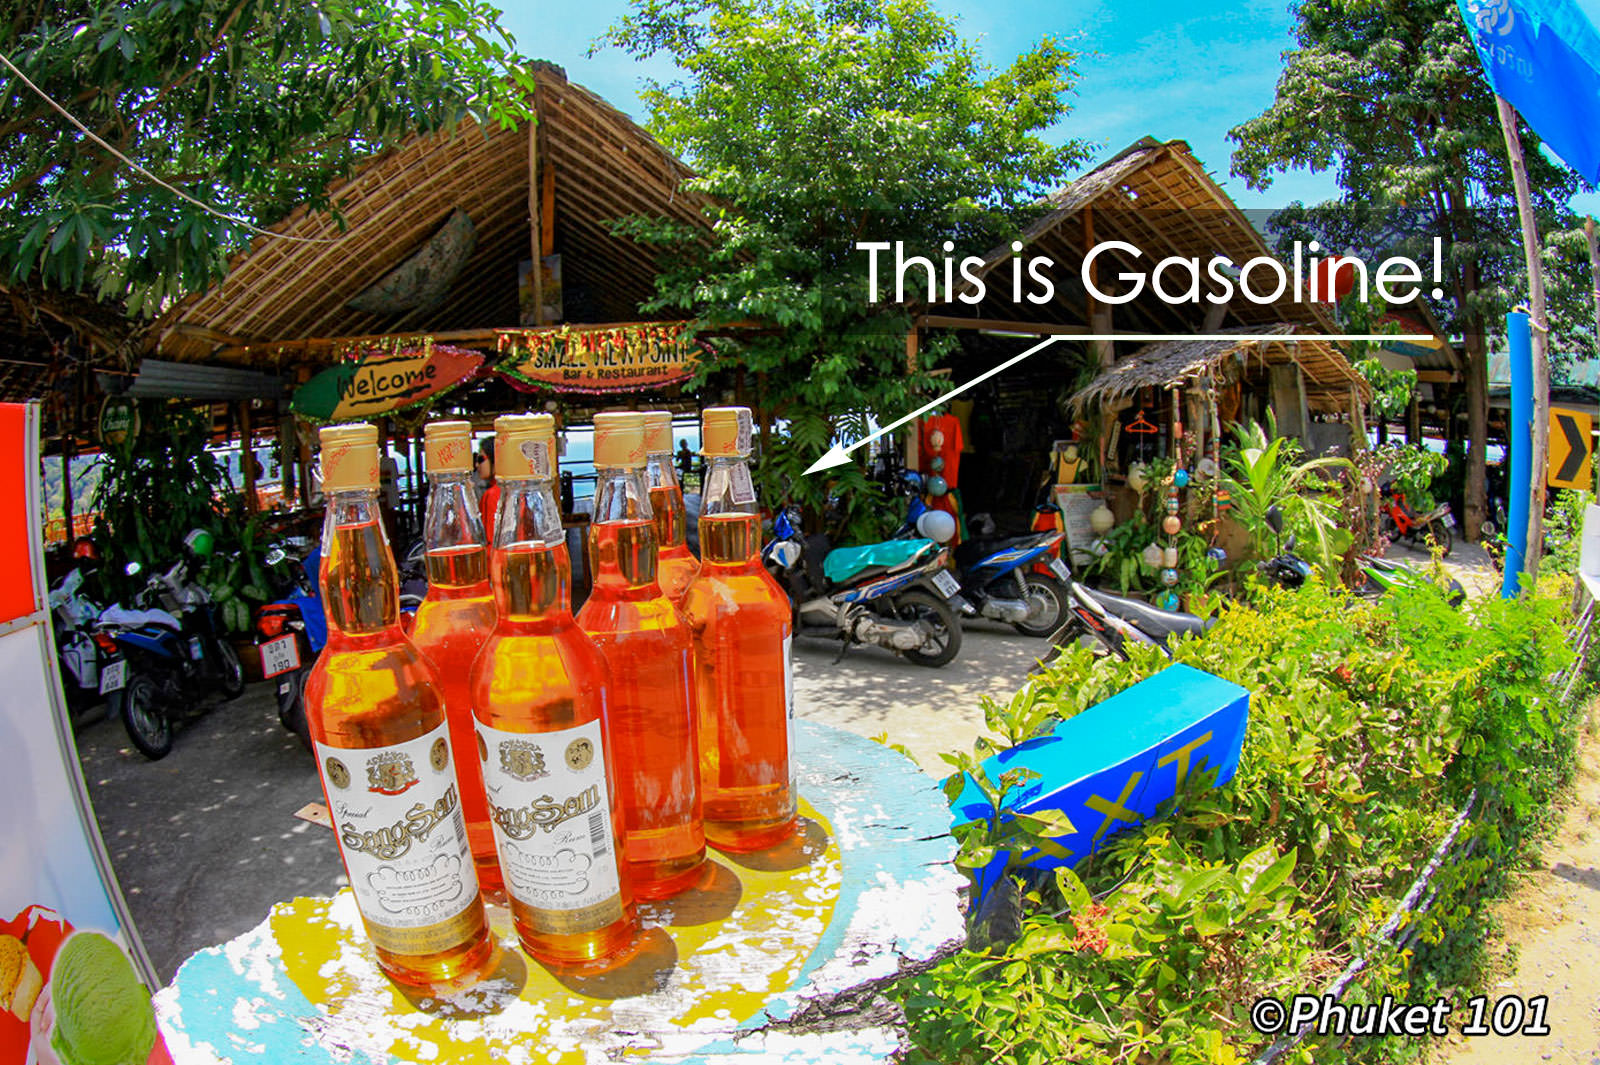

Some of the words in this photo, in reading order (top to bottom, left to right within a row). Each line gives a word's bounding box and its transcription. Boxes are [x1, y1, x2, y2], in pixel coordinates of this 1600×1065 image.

[563, 369, 582, 380] Bar
[587, 369, 594, 379] &
[597, 365, 668, 379] Restaurant
[336, 364, 437, 402] Welcome
[334, 800, 373, 819] Special
[554, 831, 586, 845] Rum
